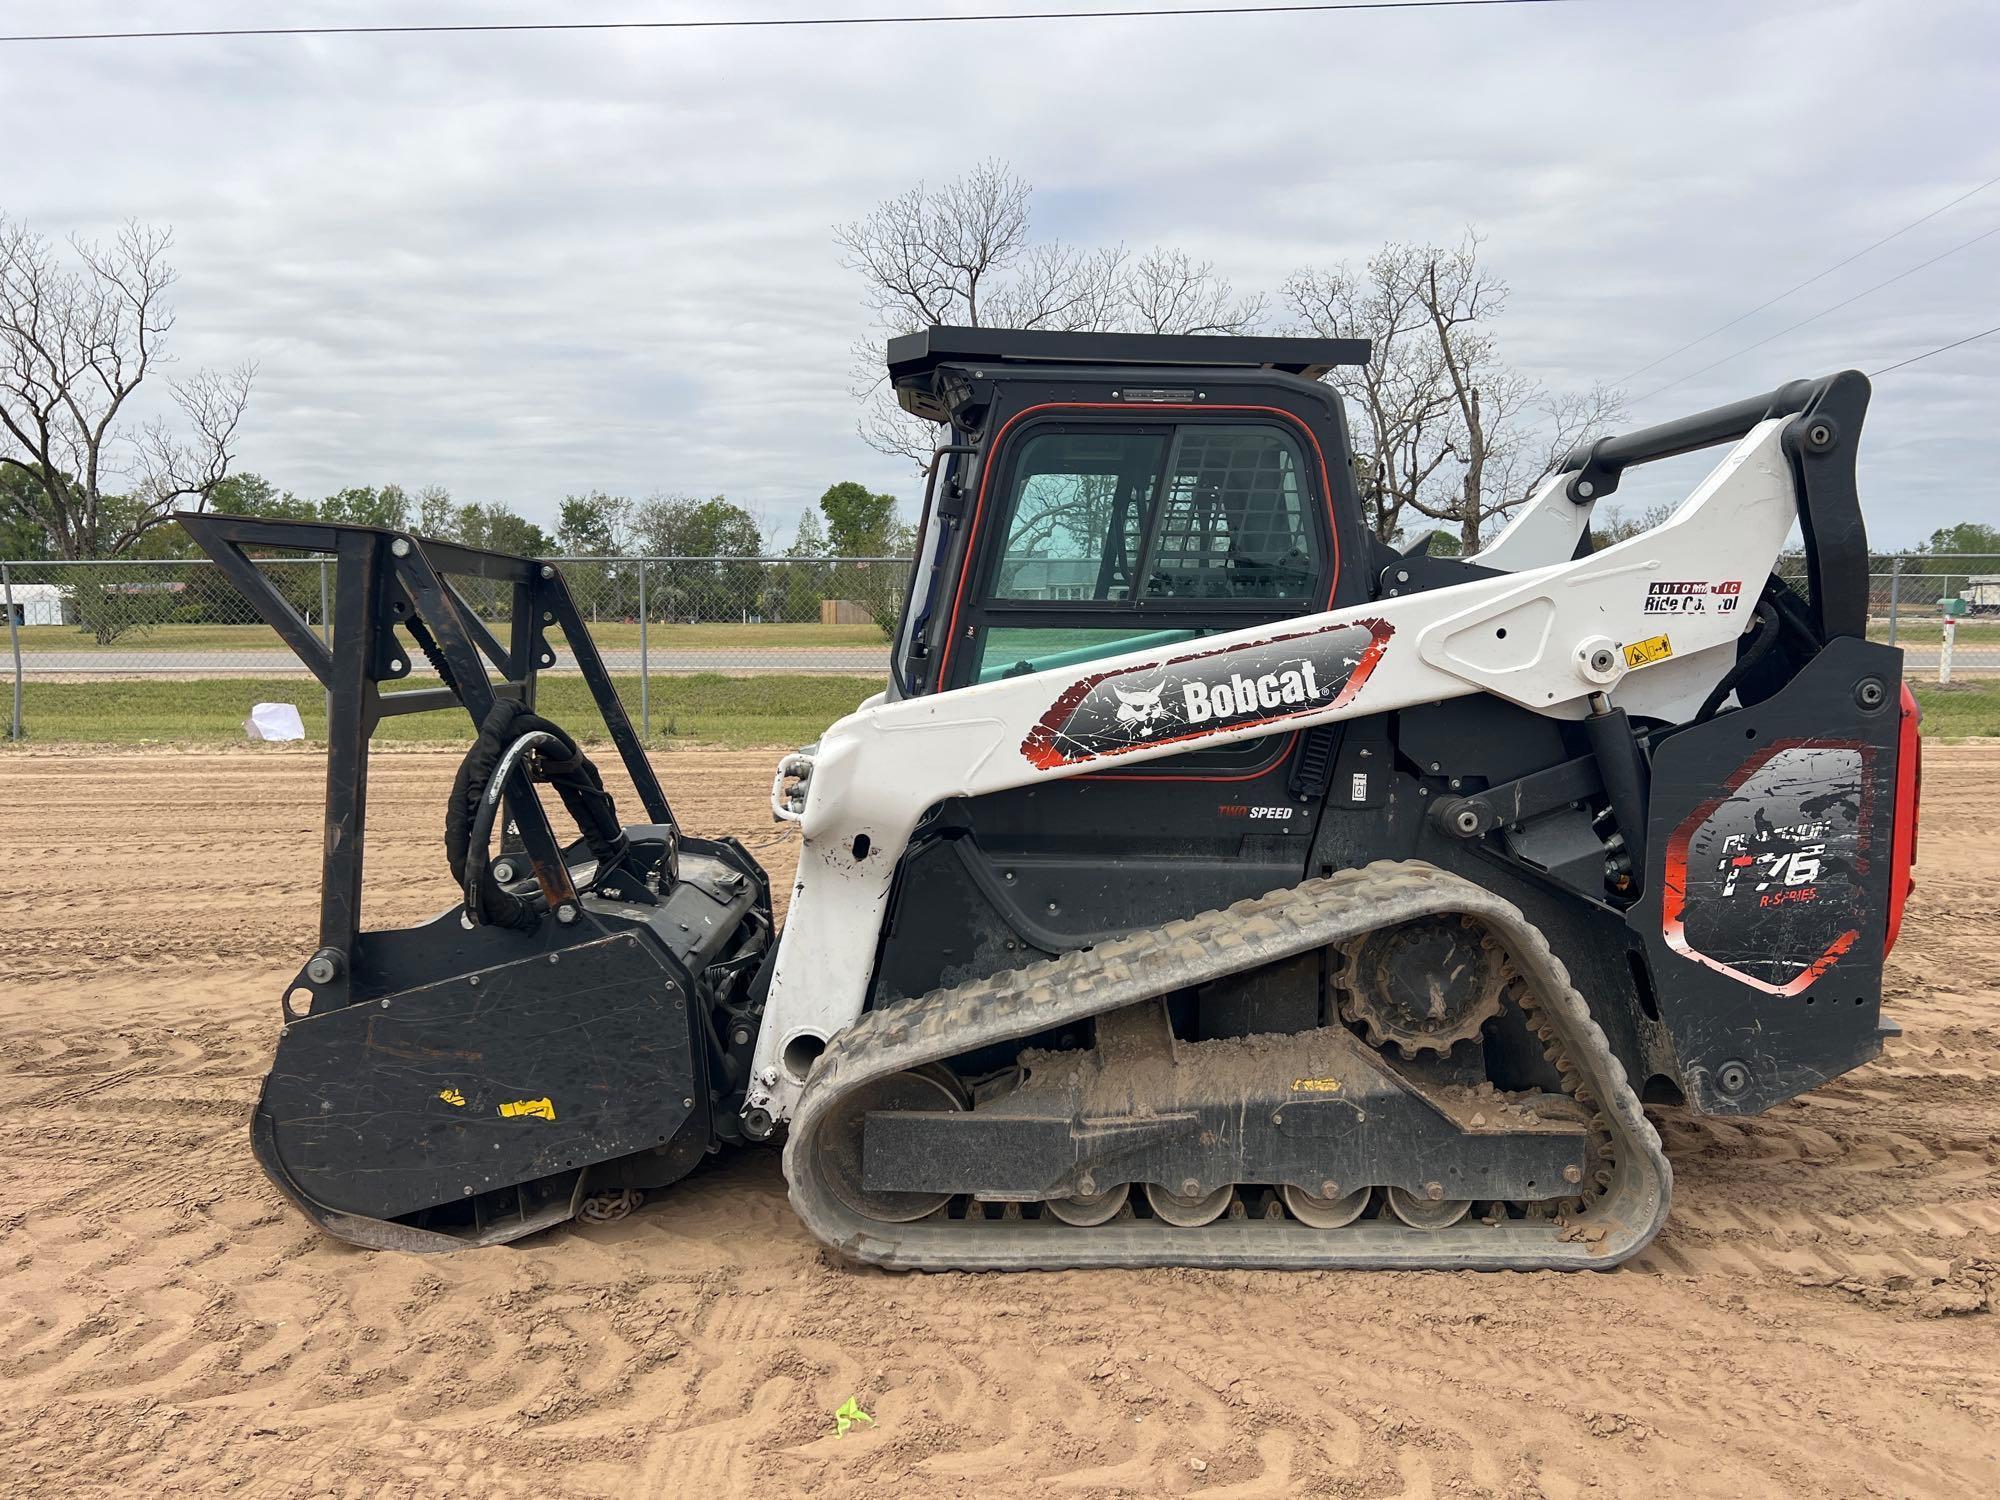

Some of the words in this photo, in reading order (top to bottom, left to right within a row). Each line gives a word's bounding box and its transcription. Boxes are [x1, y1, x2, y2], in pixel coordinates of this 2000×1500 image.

[1651, 583, 1739, 595] AUTOMTIC
[1644, 596, 1679, 611] Ride
[1682, 596, 1739, 611] Corol
[1183, 660, 1321, 724] Bobcat
[1249, 807, 1293, 819] SPEED
